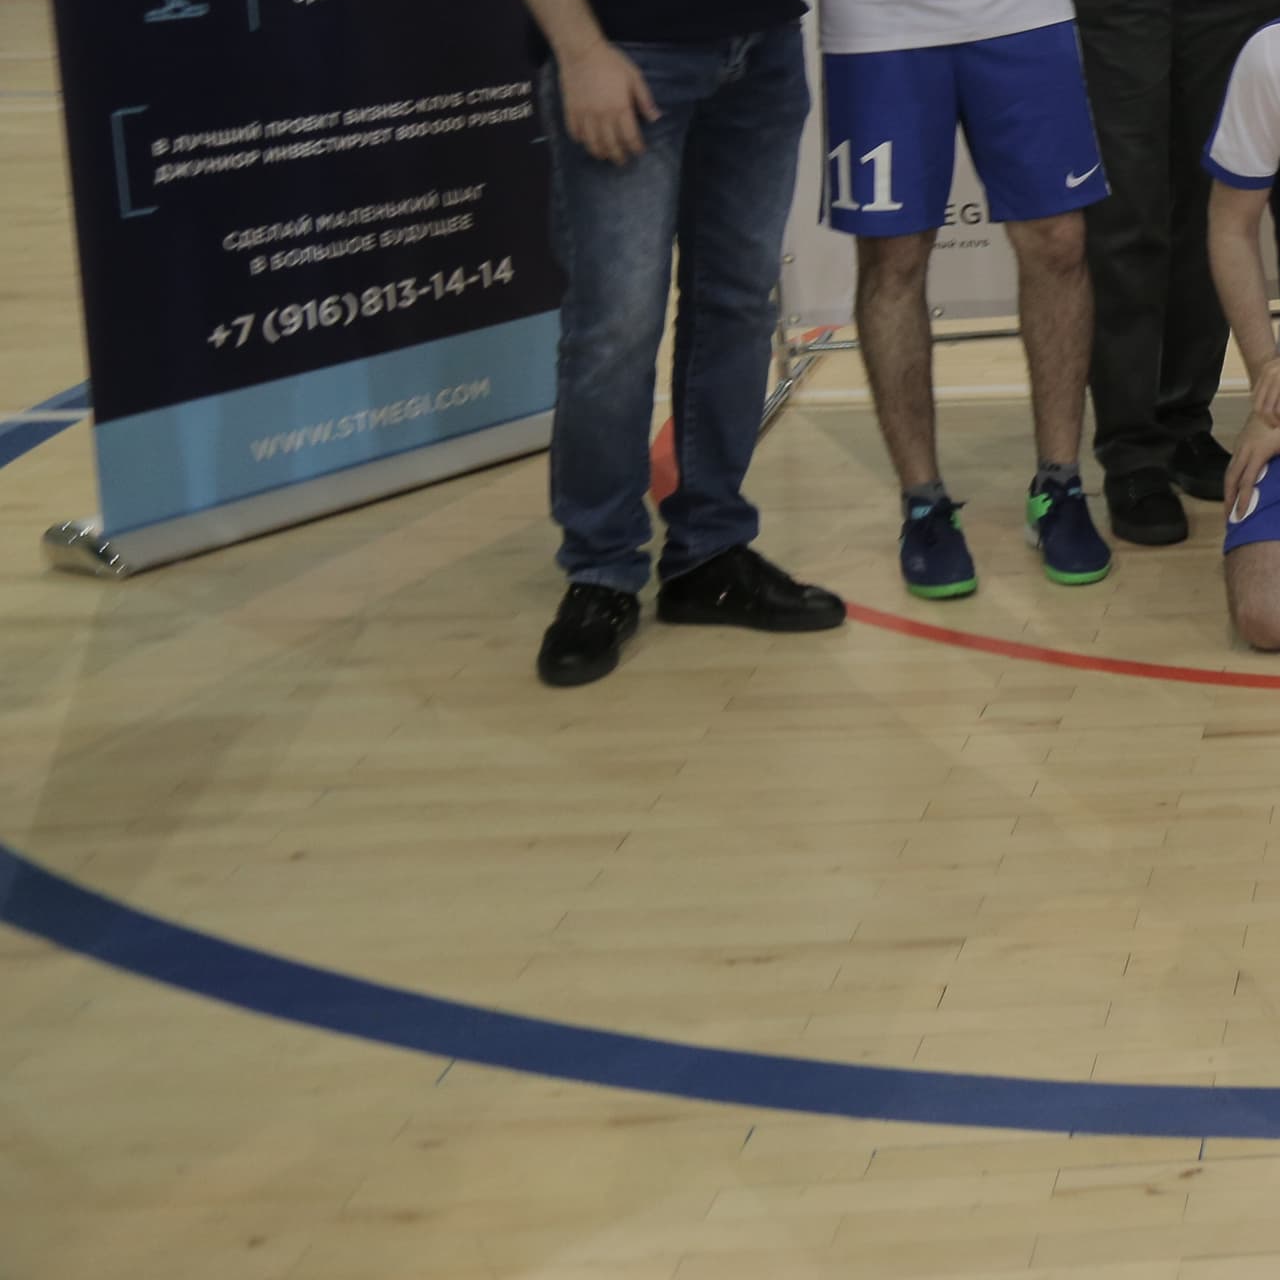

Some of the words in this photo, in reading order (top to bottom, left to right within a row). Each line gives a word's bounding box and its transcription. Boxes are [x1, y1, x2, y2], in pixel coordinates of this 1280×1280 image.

[828, 139, 903, 212] 11
[222, 214, 313, 252] СДЕЛАЙ
[442, 182, 487, 207] ШАГ
[270, 232, 378, 272] БОЛЬШОЕ
[379, 213, 475, 248] БУДУЩЕЕ
[207, 313, 255, 349] +7
[250, 377, 491, 462] WWW.STMEGI.COM
